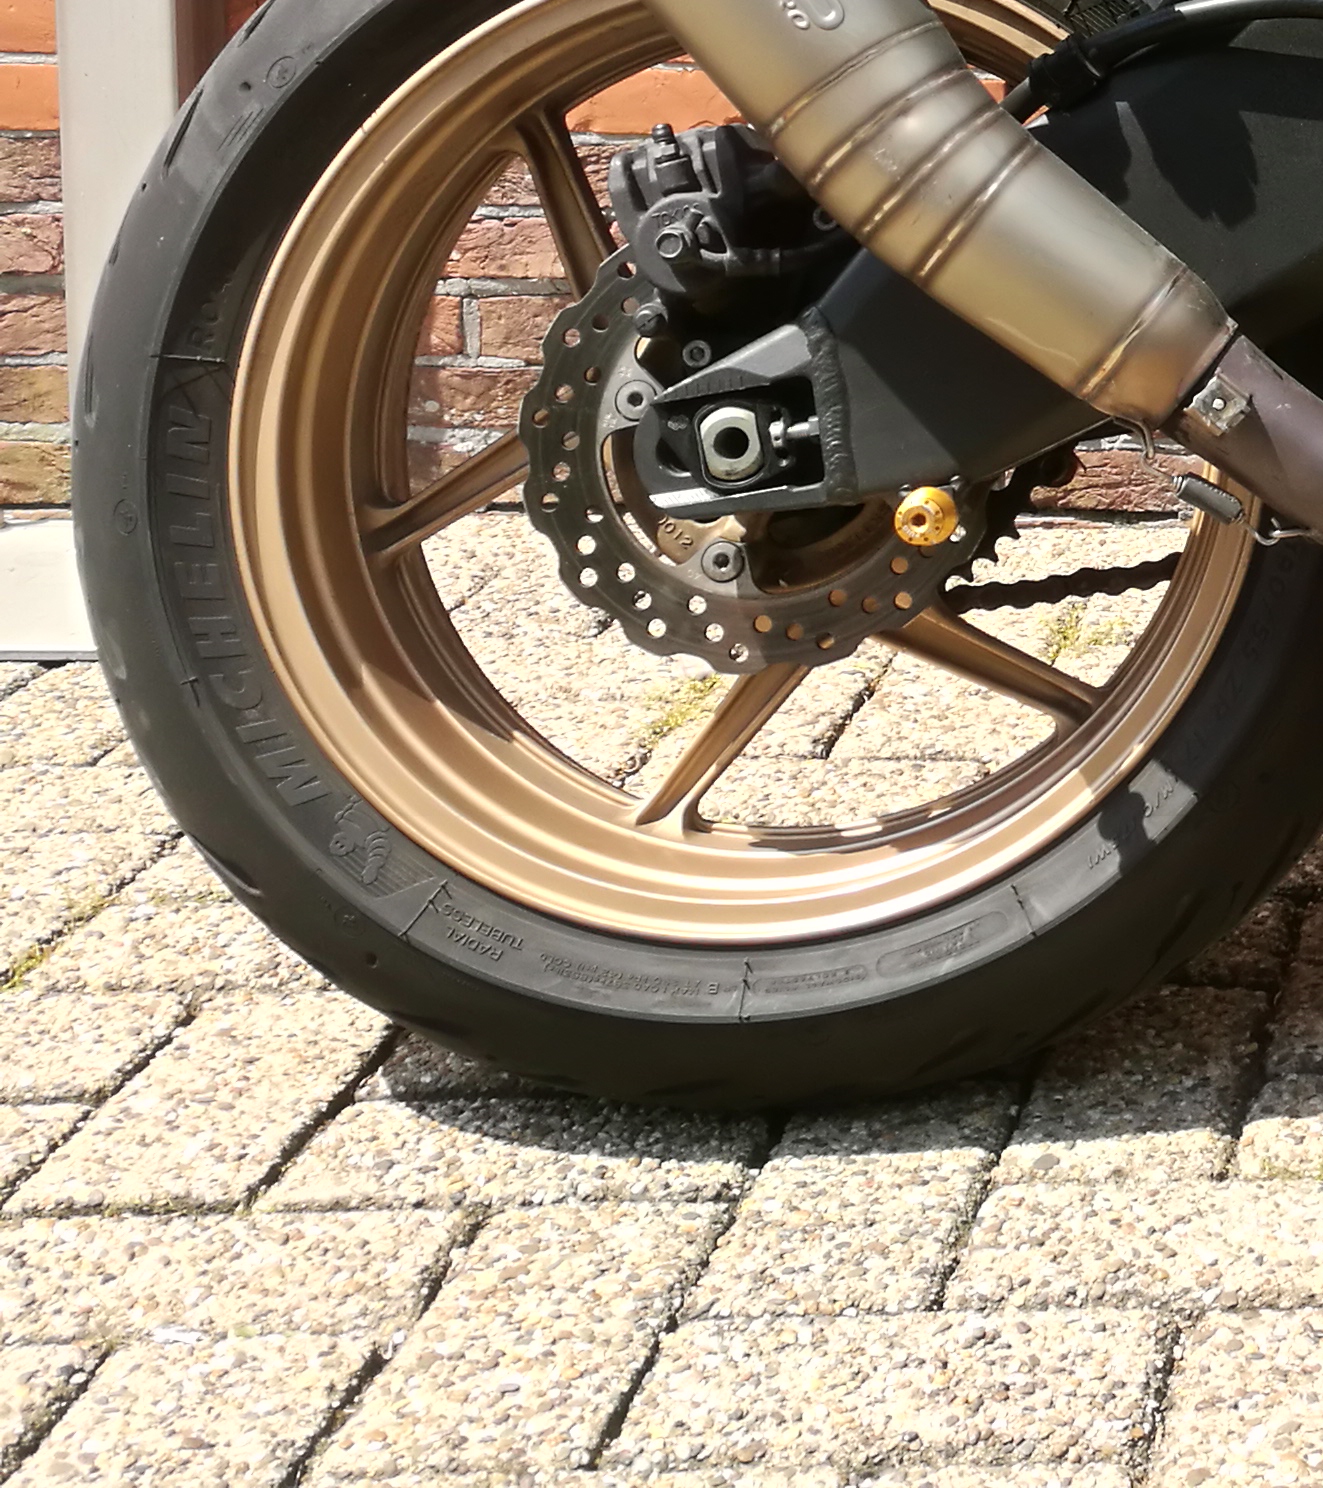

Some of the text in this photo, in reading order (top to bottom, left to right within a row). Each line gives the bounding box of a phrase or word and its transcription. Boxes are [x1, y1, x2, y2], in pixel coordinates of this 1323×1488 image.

[165, 407, 334, 809] MICHELIN
[441, 903, 524, 951] TUBELESS
[447, 926, 504, 962] RADIAL
